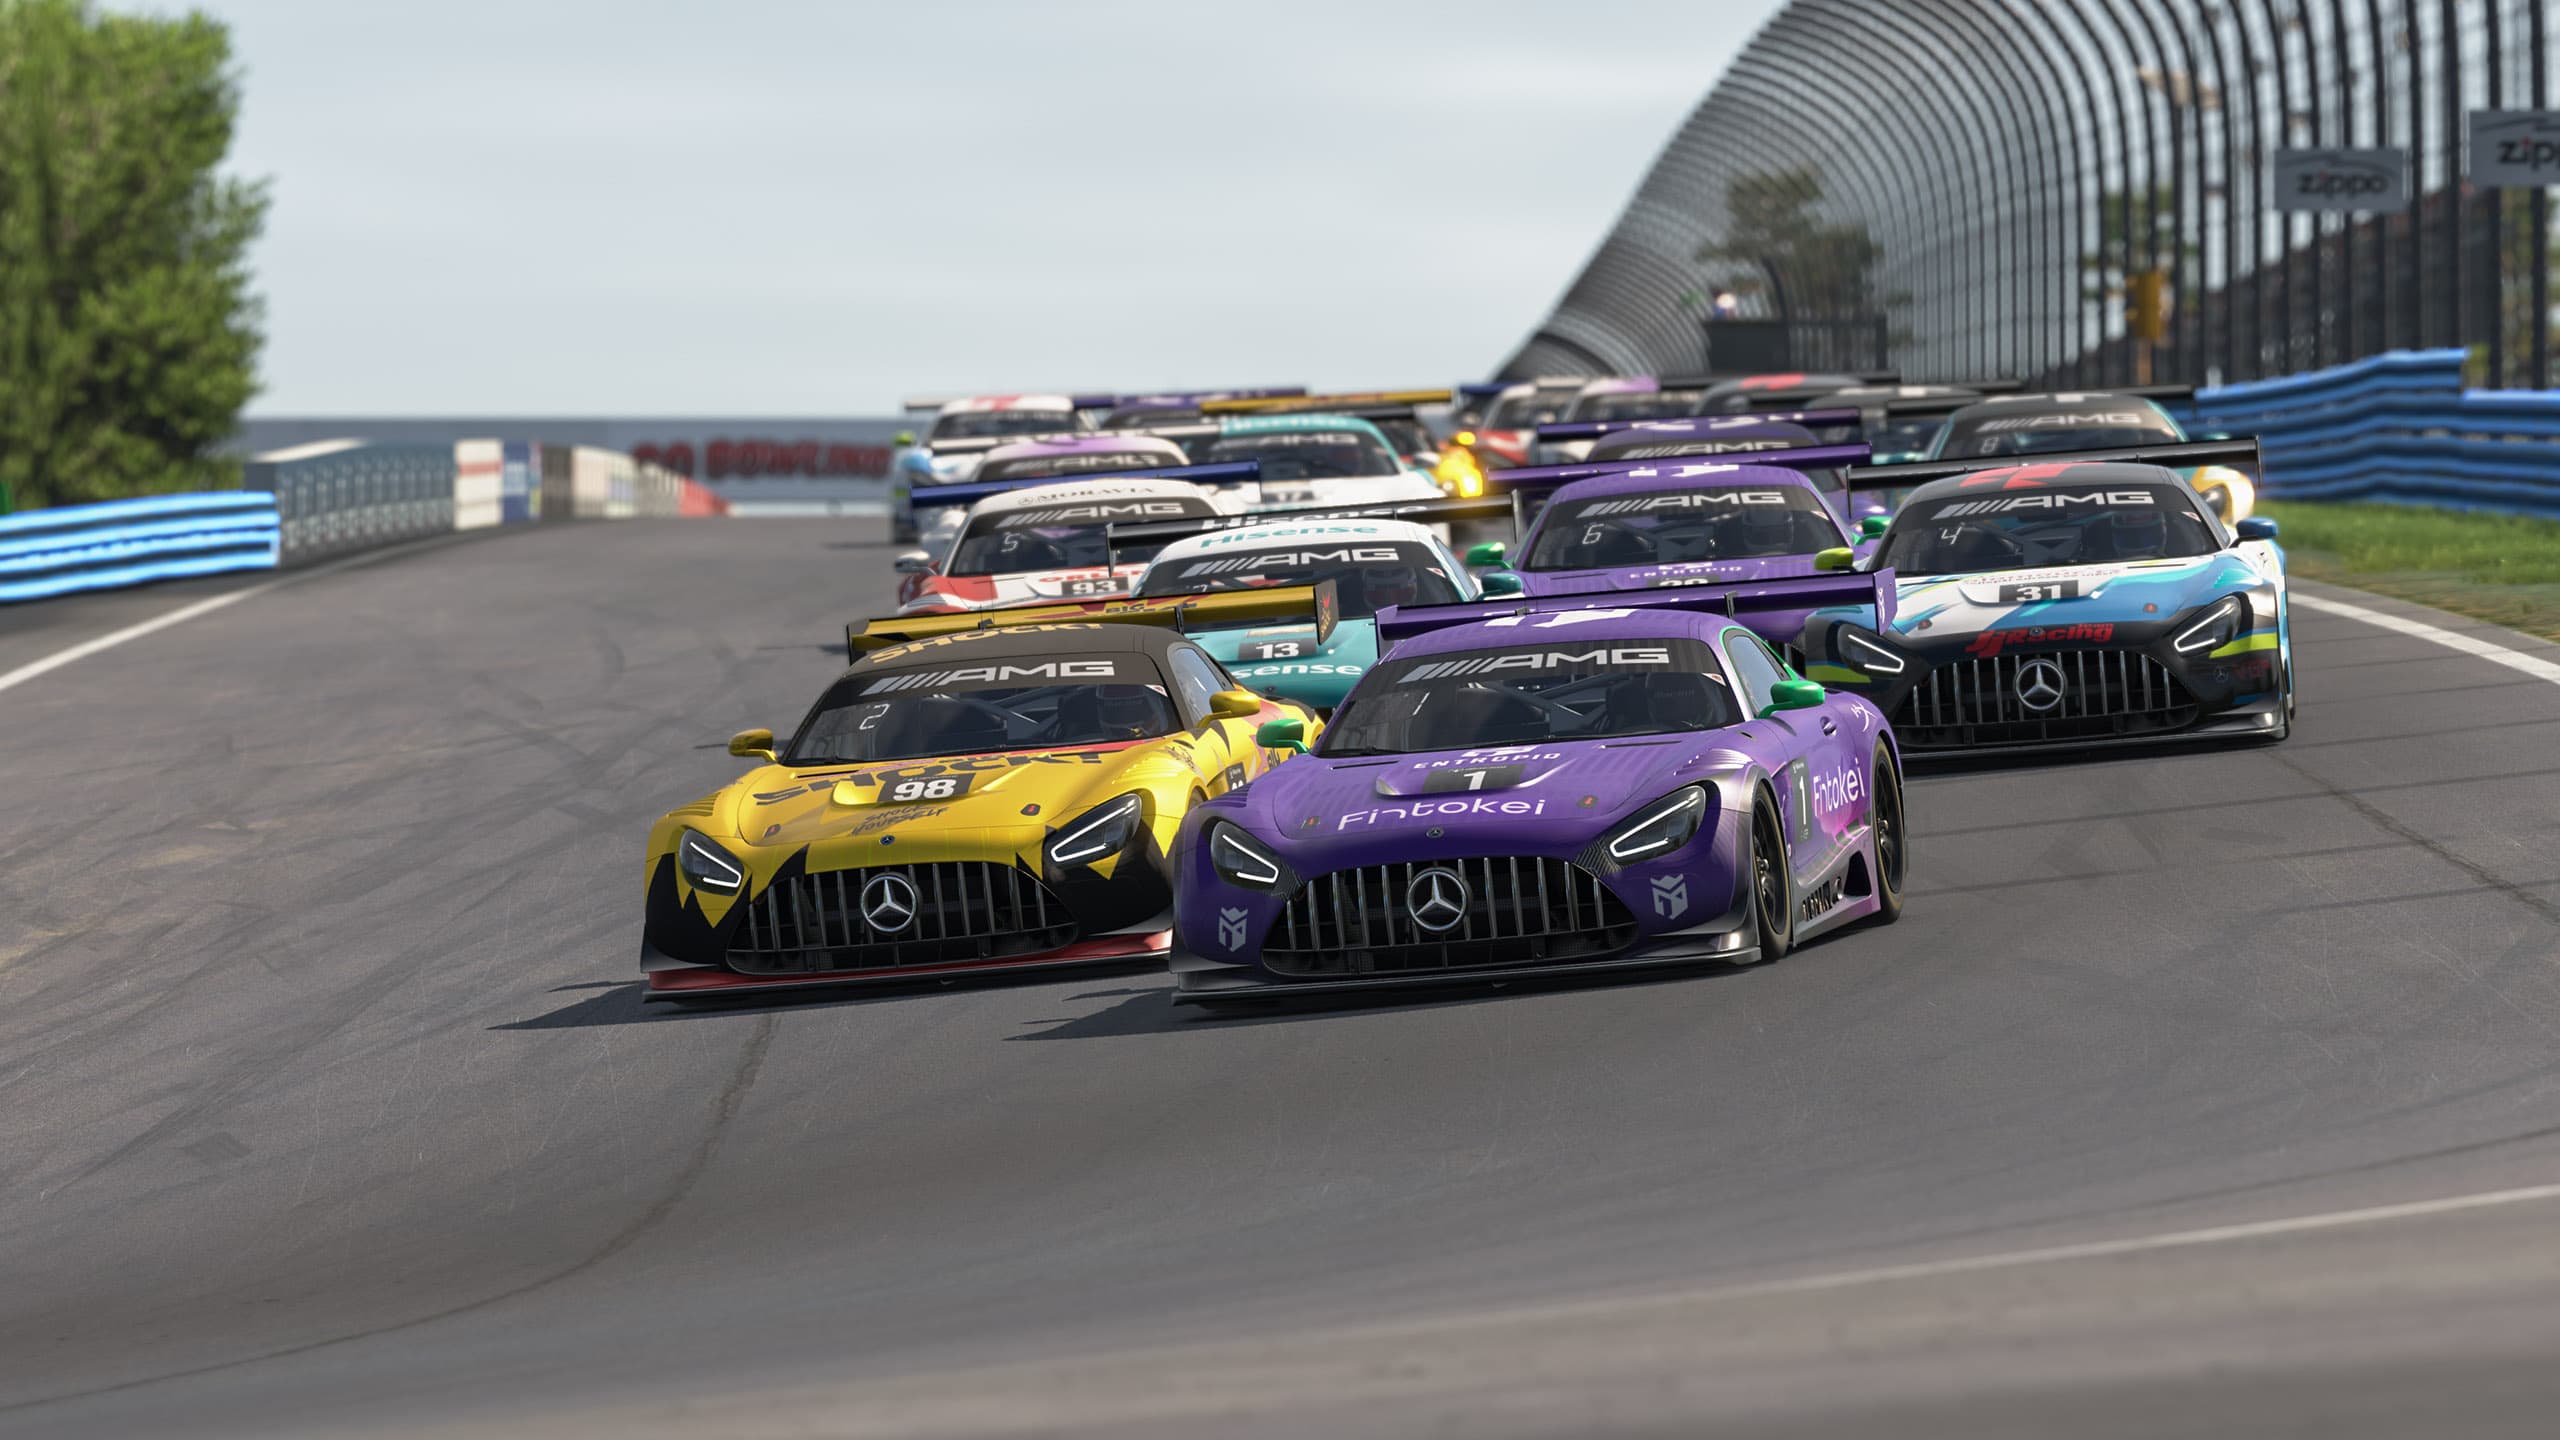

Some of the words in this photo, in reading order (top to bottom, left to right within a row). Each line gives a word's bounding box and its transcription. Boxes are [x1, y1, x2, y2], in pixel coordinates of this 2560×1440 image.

[2497, 137, 2560, 171] zip
[2296, 170, 2388, 198] zippo
[2030, 413, 2141, 428] AMG
[1258, 433, 1359, 446] AMG
[1053, 454, 1160, 469] AMG
[1056, 502, 1185, 519] AMG
[1646, 491, 1785, 511] AMG
[2001, 490, 2155, 512] AMG
[1200, 525, 1378, 549] Hisense
[1582, 523, 1605, 545] 6
[1941, 525, 1962, 545] 4
[1249, 547, 1400, 570] AMG
[1071, 579, 1118, 595] 93
[2015, 583, 2062, 602] 31
[1255, 642, 1300, 660] 13
[1478, 647, 1670, 673] AMG
[936, 660, 1115, 687] AMG
[1230, 663, 1363, 679] sense
[858, 703, 890, 730] 2
[892, 778, 956, 802] 98
[1462, 770, 1488, 791] 1
[1812, 756, 1866, 817] Fintokei
[1799, 775, 1807, 825] 1
[1337, 798, 1546, 831] Fintokei
